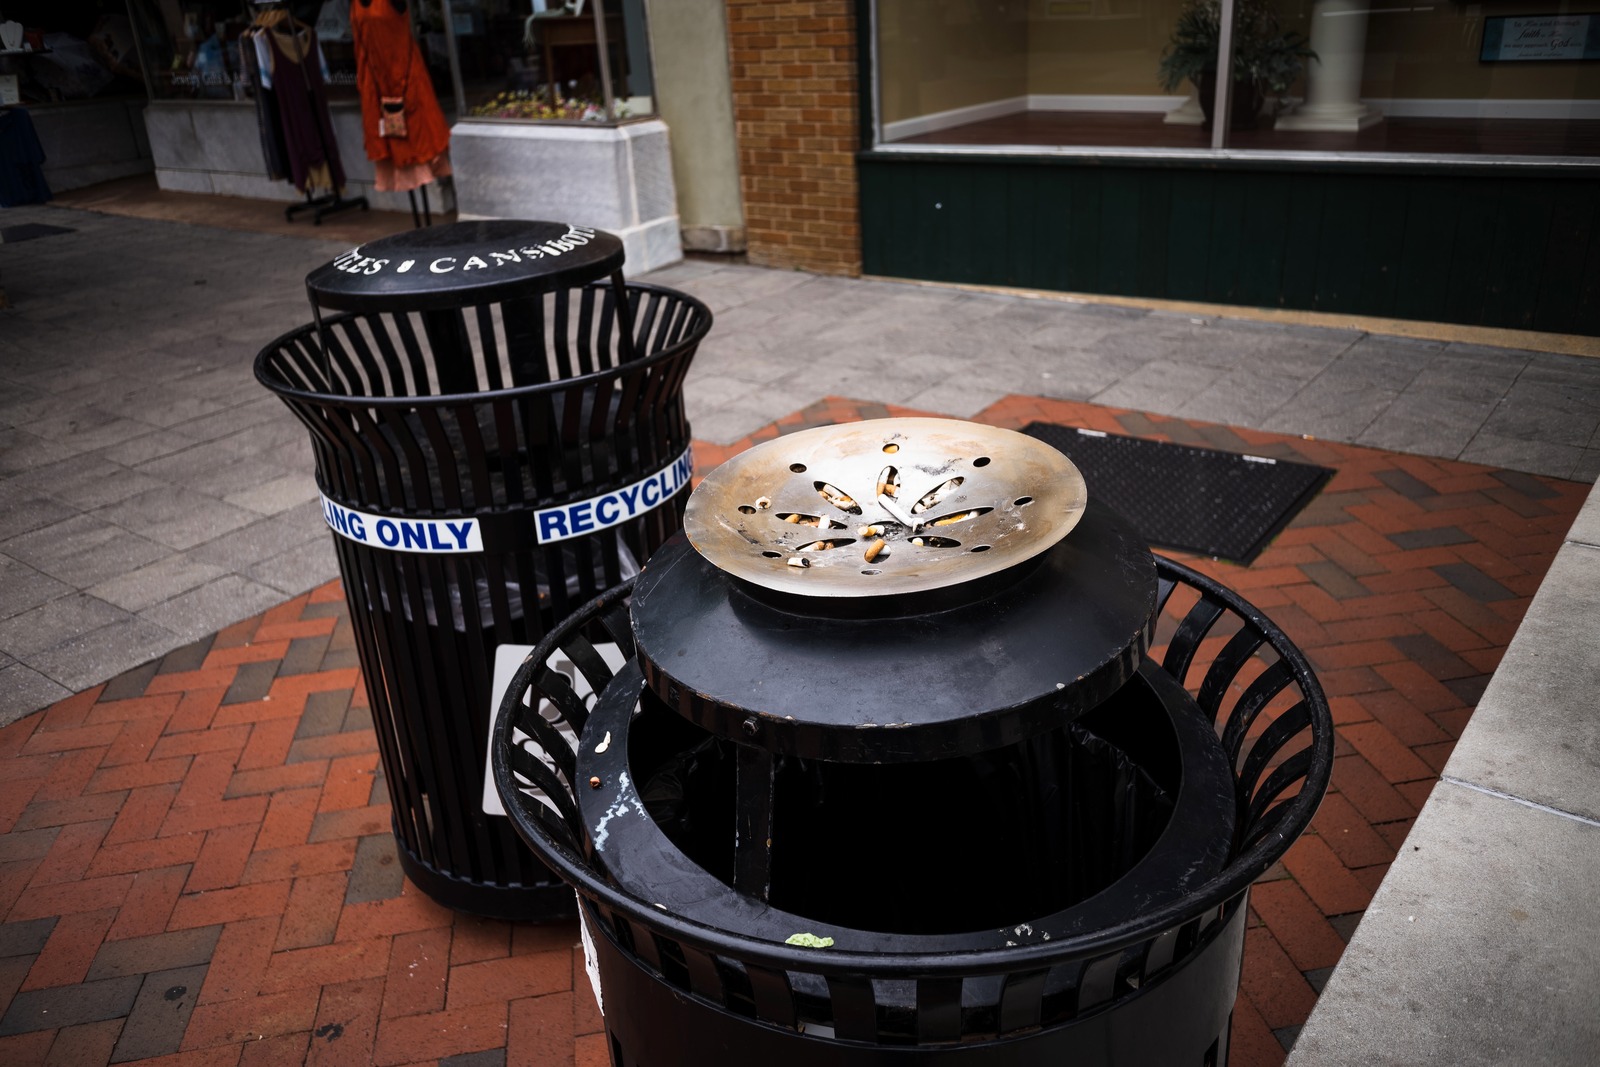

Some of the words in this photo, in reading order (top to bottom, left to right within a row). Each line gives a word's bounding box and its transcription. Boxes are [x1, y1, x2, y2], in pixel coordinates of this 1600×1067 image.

[1550, 37, 1572, 51] God
[429, 244, 544, 274] CANS
[321, 495, 367, 541] LING
[376, 519, 473, 551] ONLY
